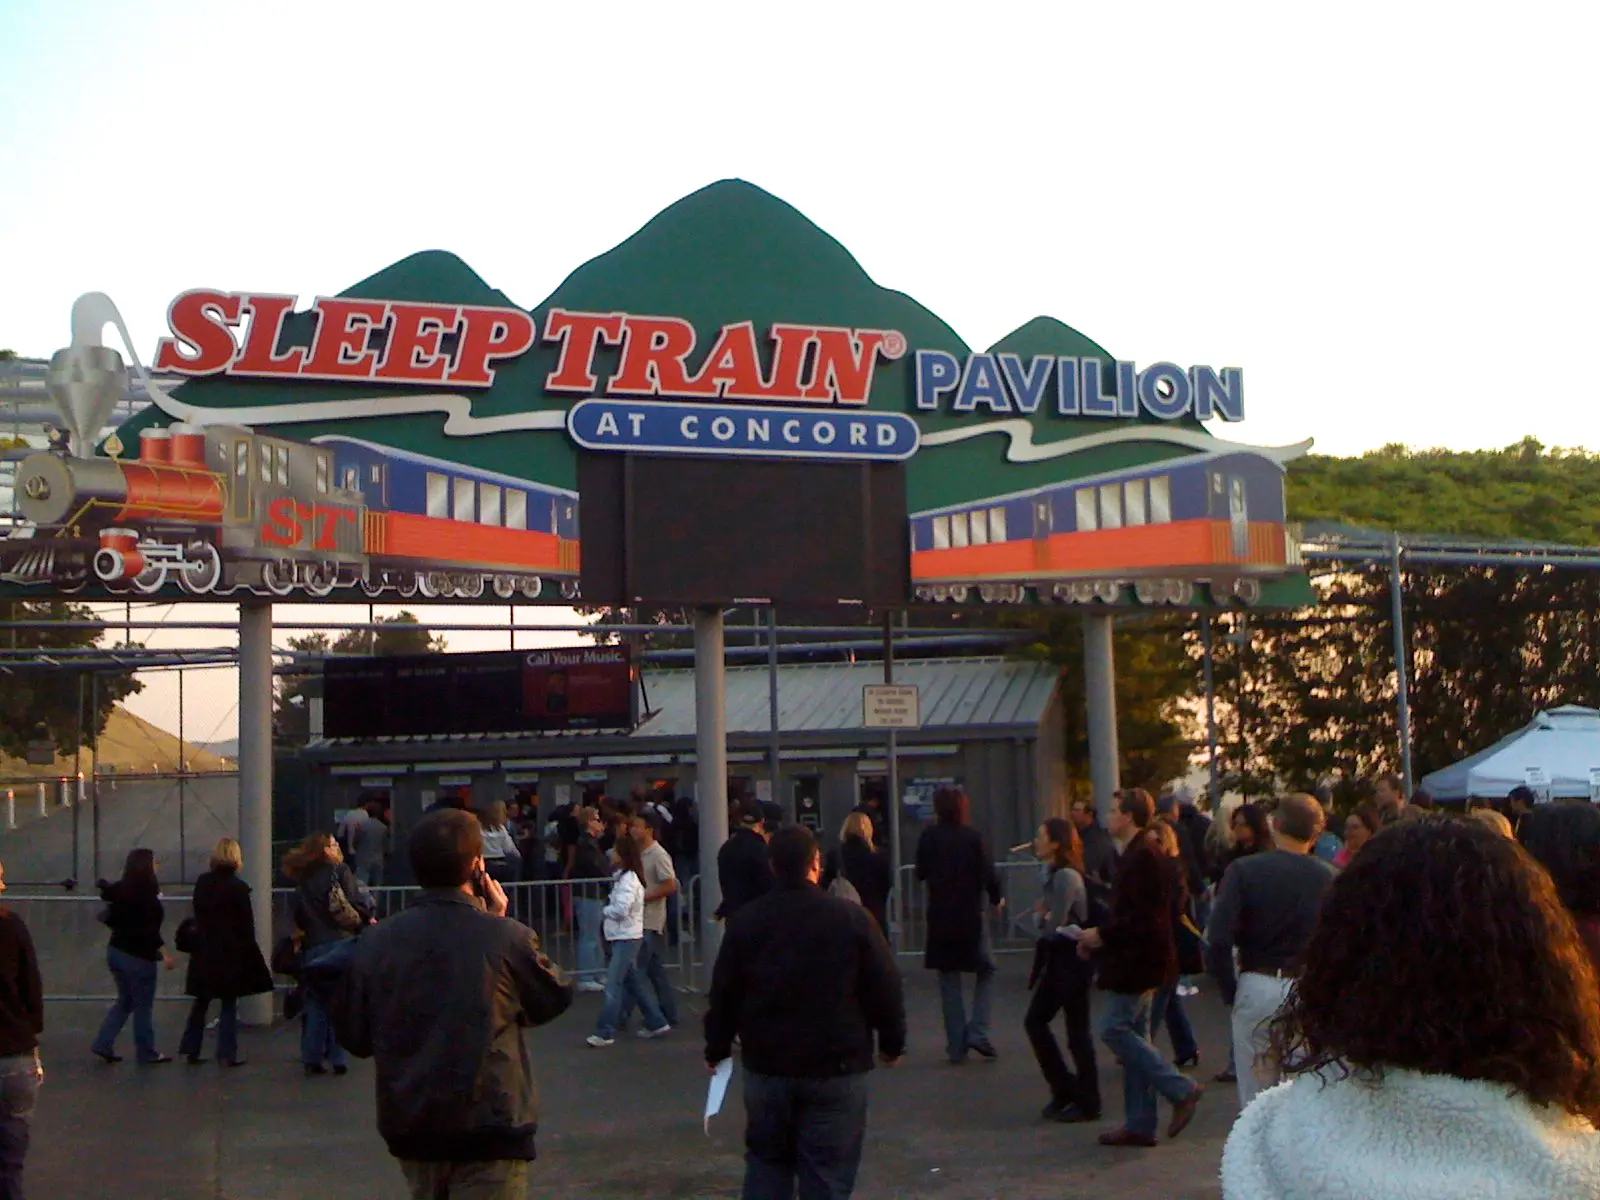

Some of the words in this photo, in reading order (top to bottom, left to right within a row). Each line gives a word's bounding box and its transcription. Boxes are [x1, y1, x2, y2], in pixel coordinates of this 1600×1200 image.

[153, 288, 536, 390] SLEEP
[915, 349, 1244, 422] PAVILION
[596, 412, 645, 437] AT
[680, 415, 898, 446] CONCORD
[260, 498, 357, 550] ST
[526, 653, 550, 667] Call
[552, 652, 580, 664] Your
